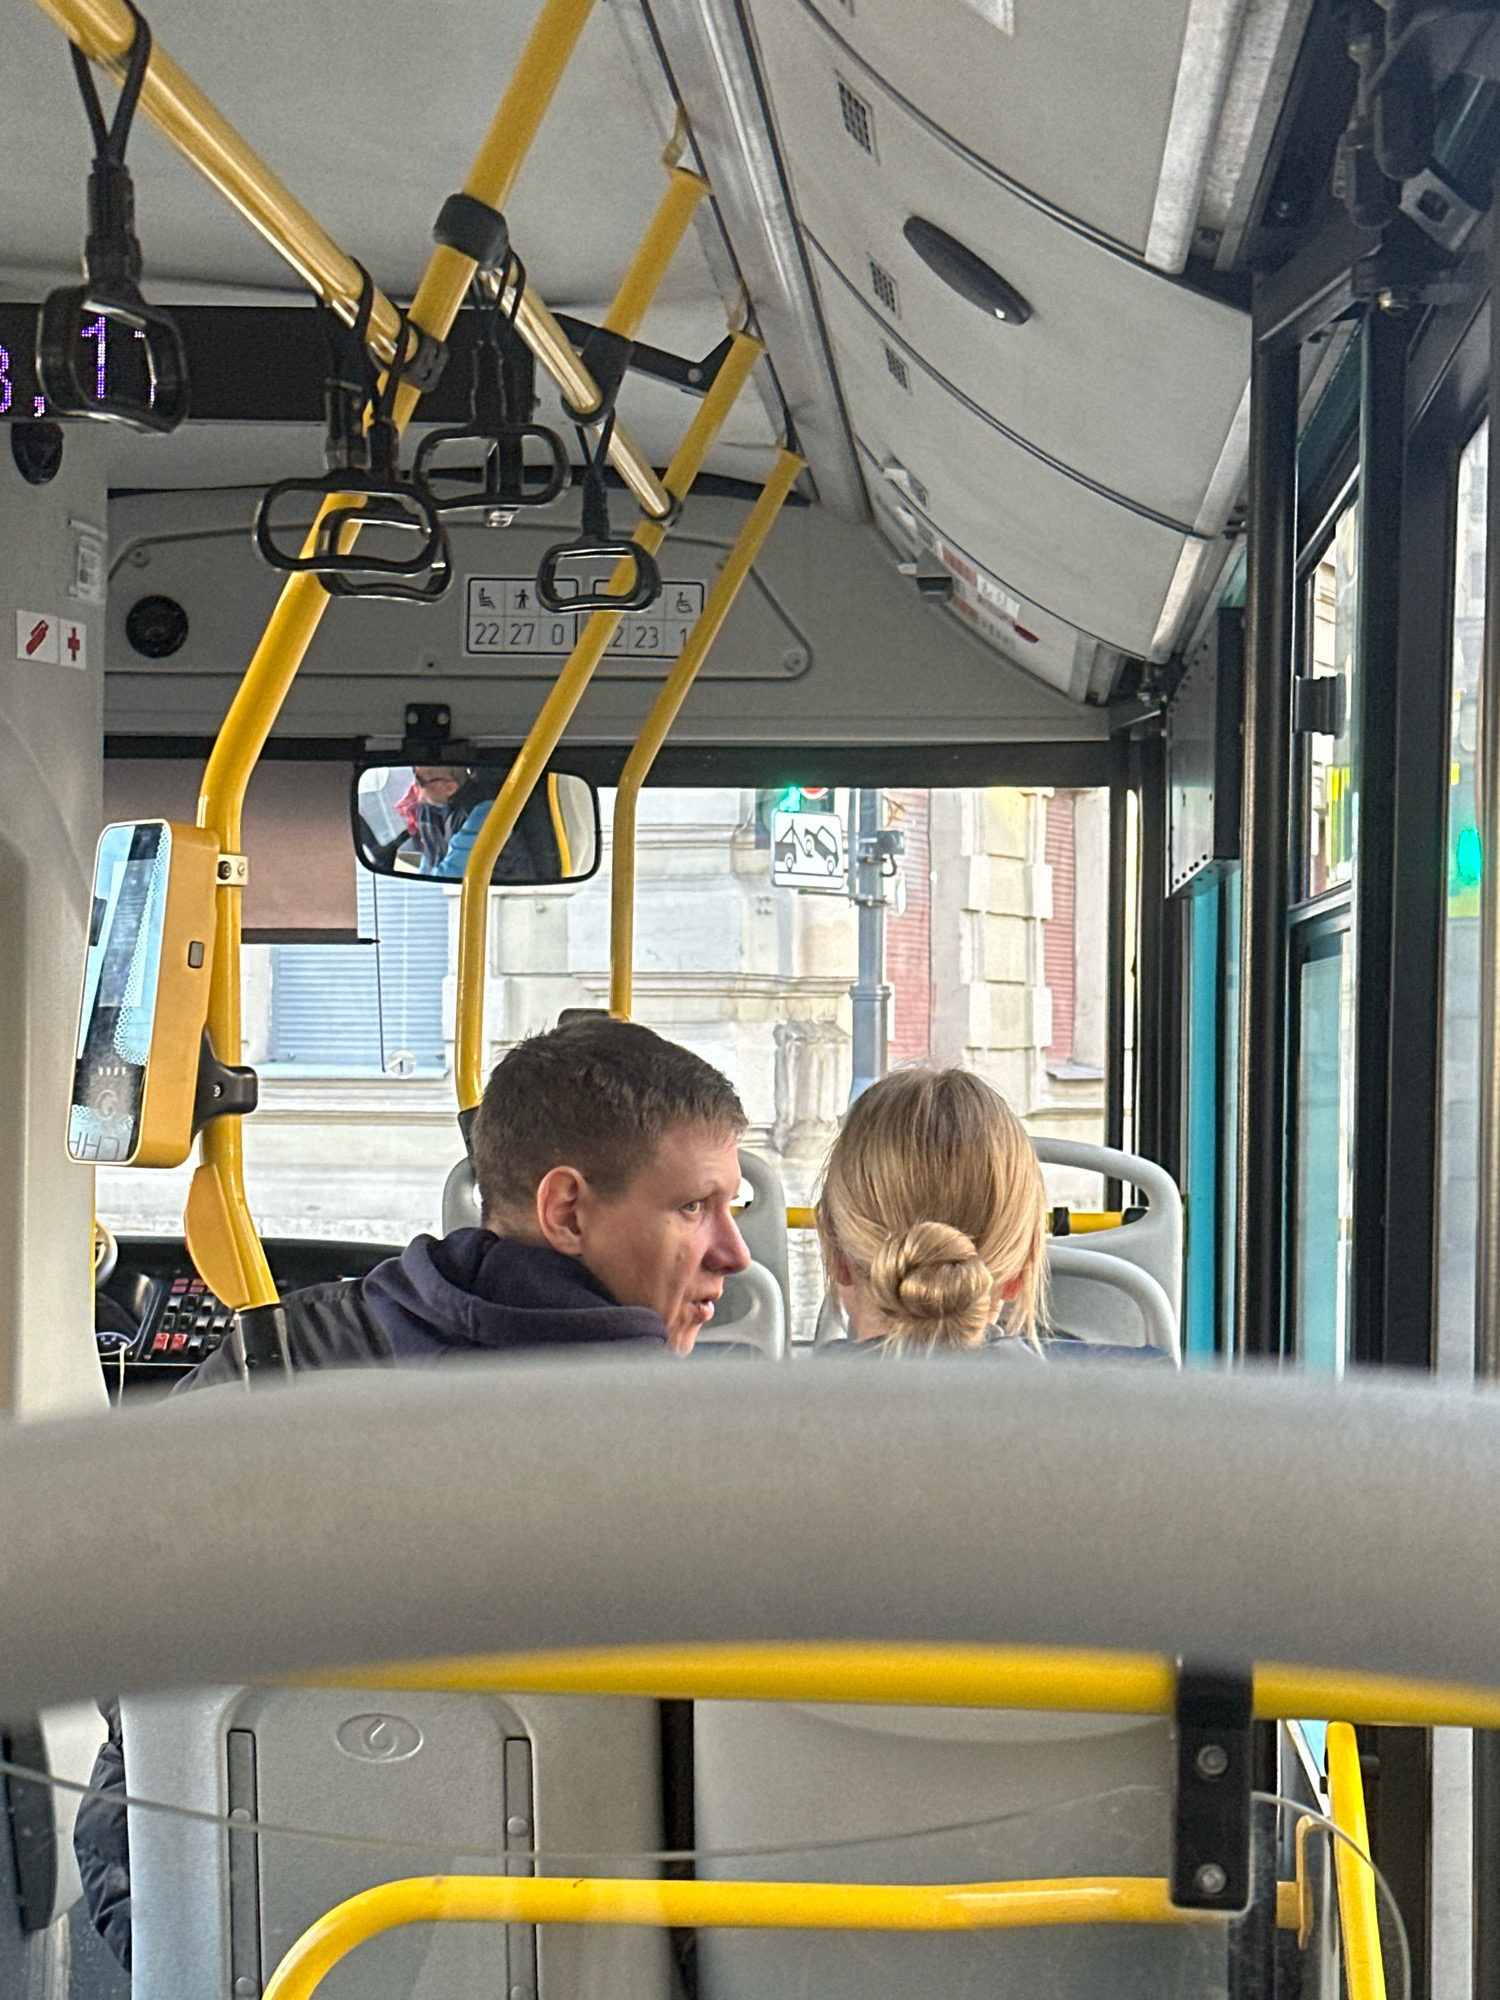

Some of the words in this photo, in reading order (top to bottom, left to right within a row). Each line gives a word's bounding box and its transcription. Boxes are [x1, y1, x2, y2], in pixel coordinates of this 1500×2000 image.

[474, 622, 499, 645] 22
[510, 623, 535, 646] 27
[551, 623, 564, 646] 0
[608, 625, 624, 647] 2
[634, 626, 658, 648] 23
[679, 627, 687, 647] 1
